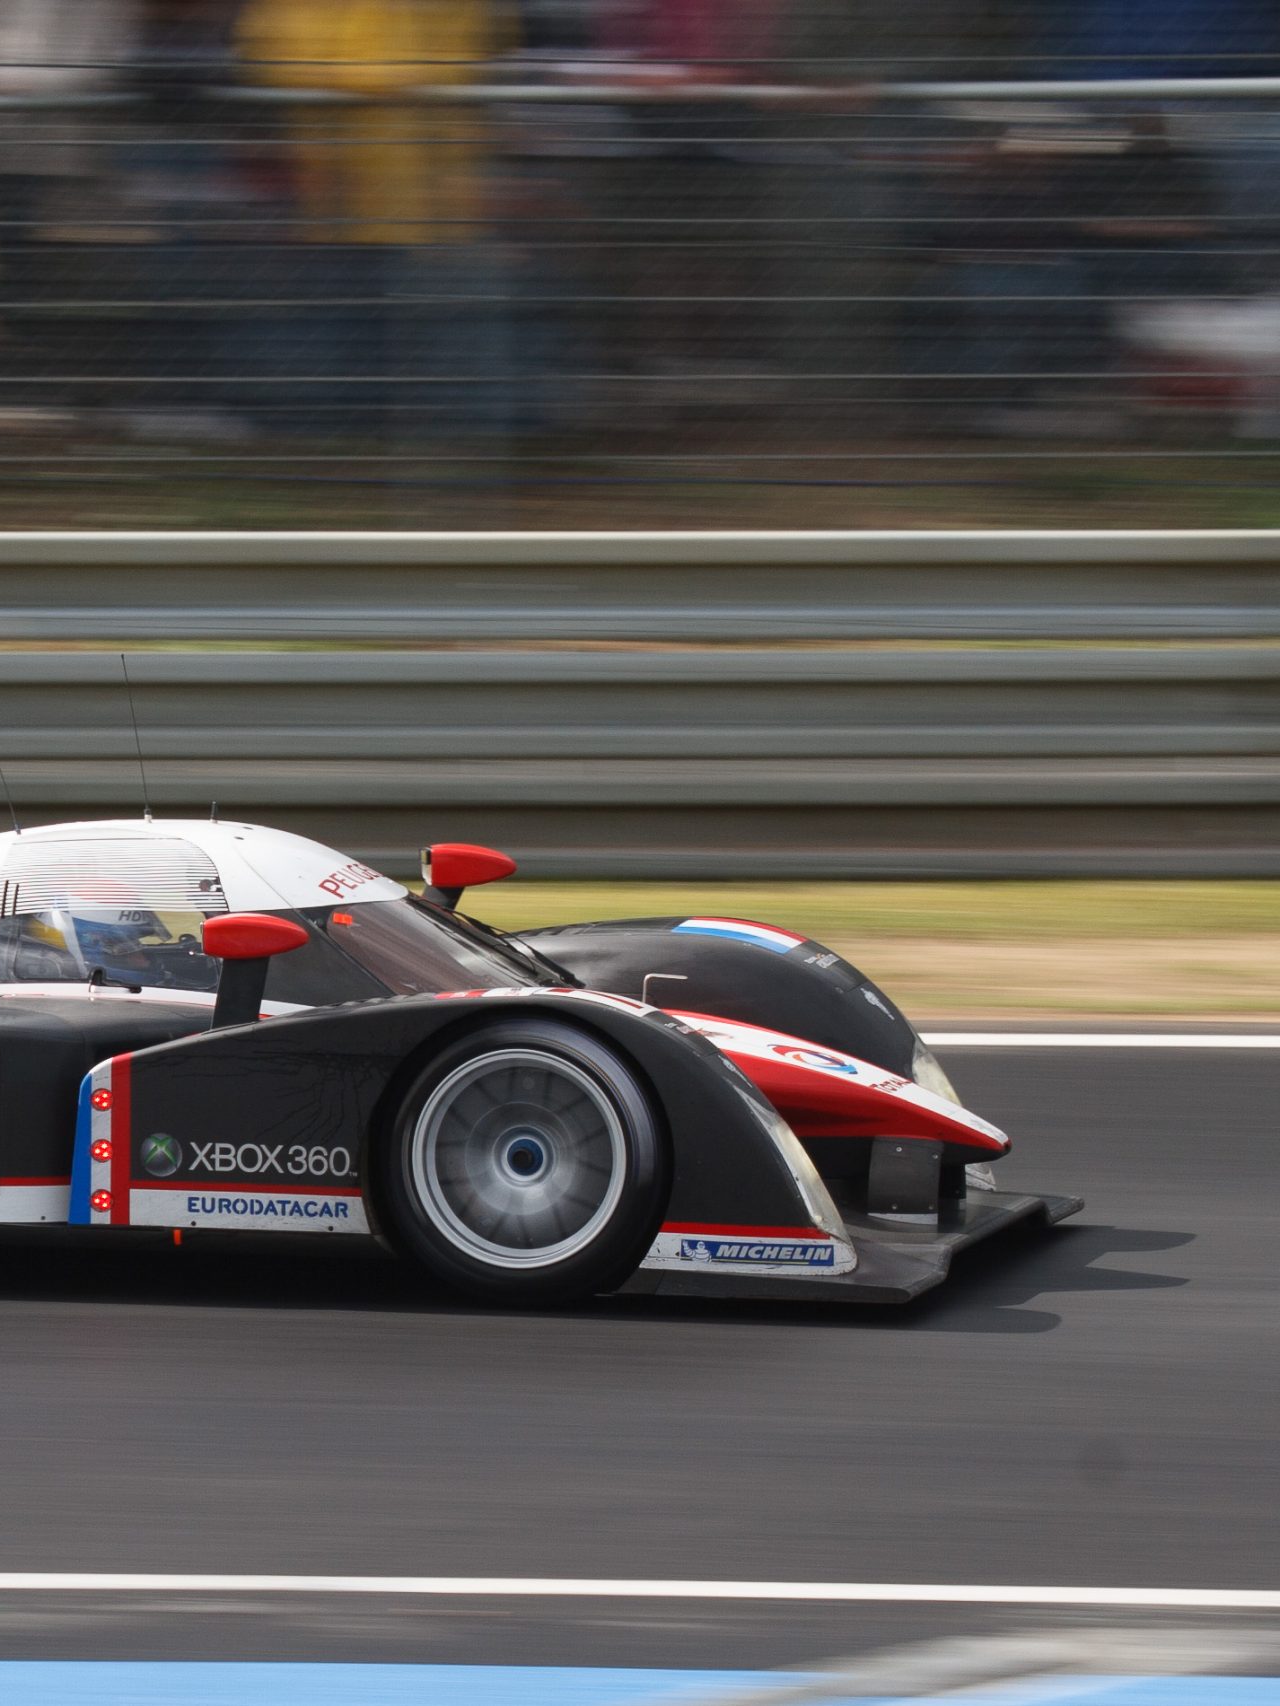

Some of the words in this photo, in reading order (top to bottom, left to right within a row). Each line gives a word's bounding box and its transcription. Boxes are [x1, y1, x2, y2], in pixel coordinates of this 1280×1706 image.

[188, 1141, 285, 1174] XBOX
[187, 1197, 349, 1218] EURODATACAR
[716, 1244, 832, 1261] MICHELIN
